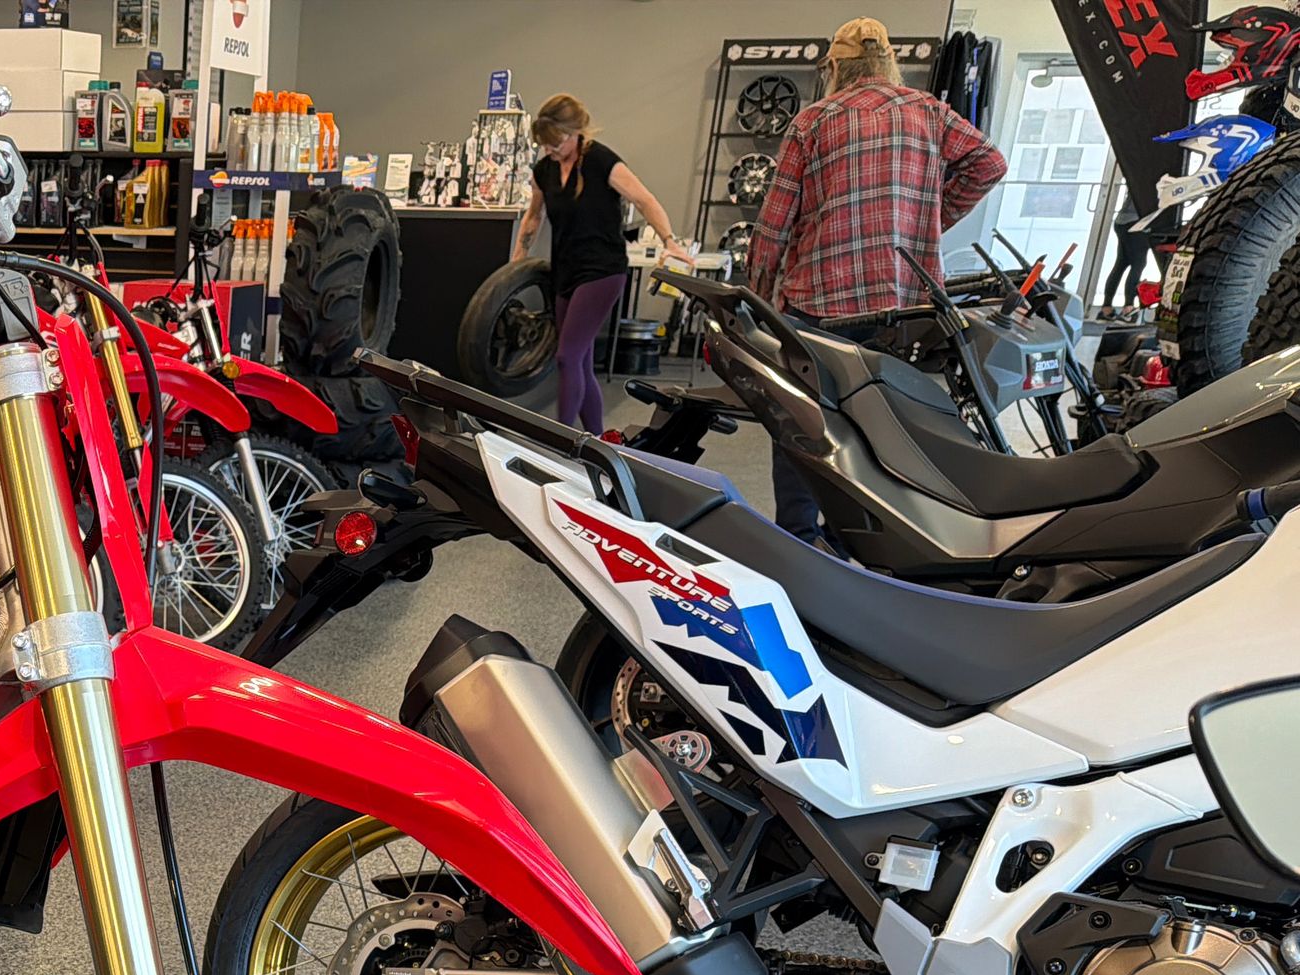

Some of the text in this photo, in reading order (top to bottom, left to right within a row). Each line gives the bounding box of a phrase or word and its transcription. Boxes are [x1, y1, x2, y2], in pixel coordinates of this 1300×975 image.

[224, 37, 249, 57] REPSOL
[743, 46, 802, 59] STI
[231, 176, 270, 186] REPSOL
[562, 522, 733, 613] ADVENTURE
[647, 585, 739, 635] SPORTS
